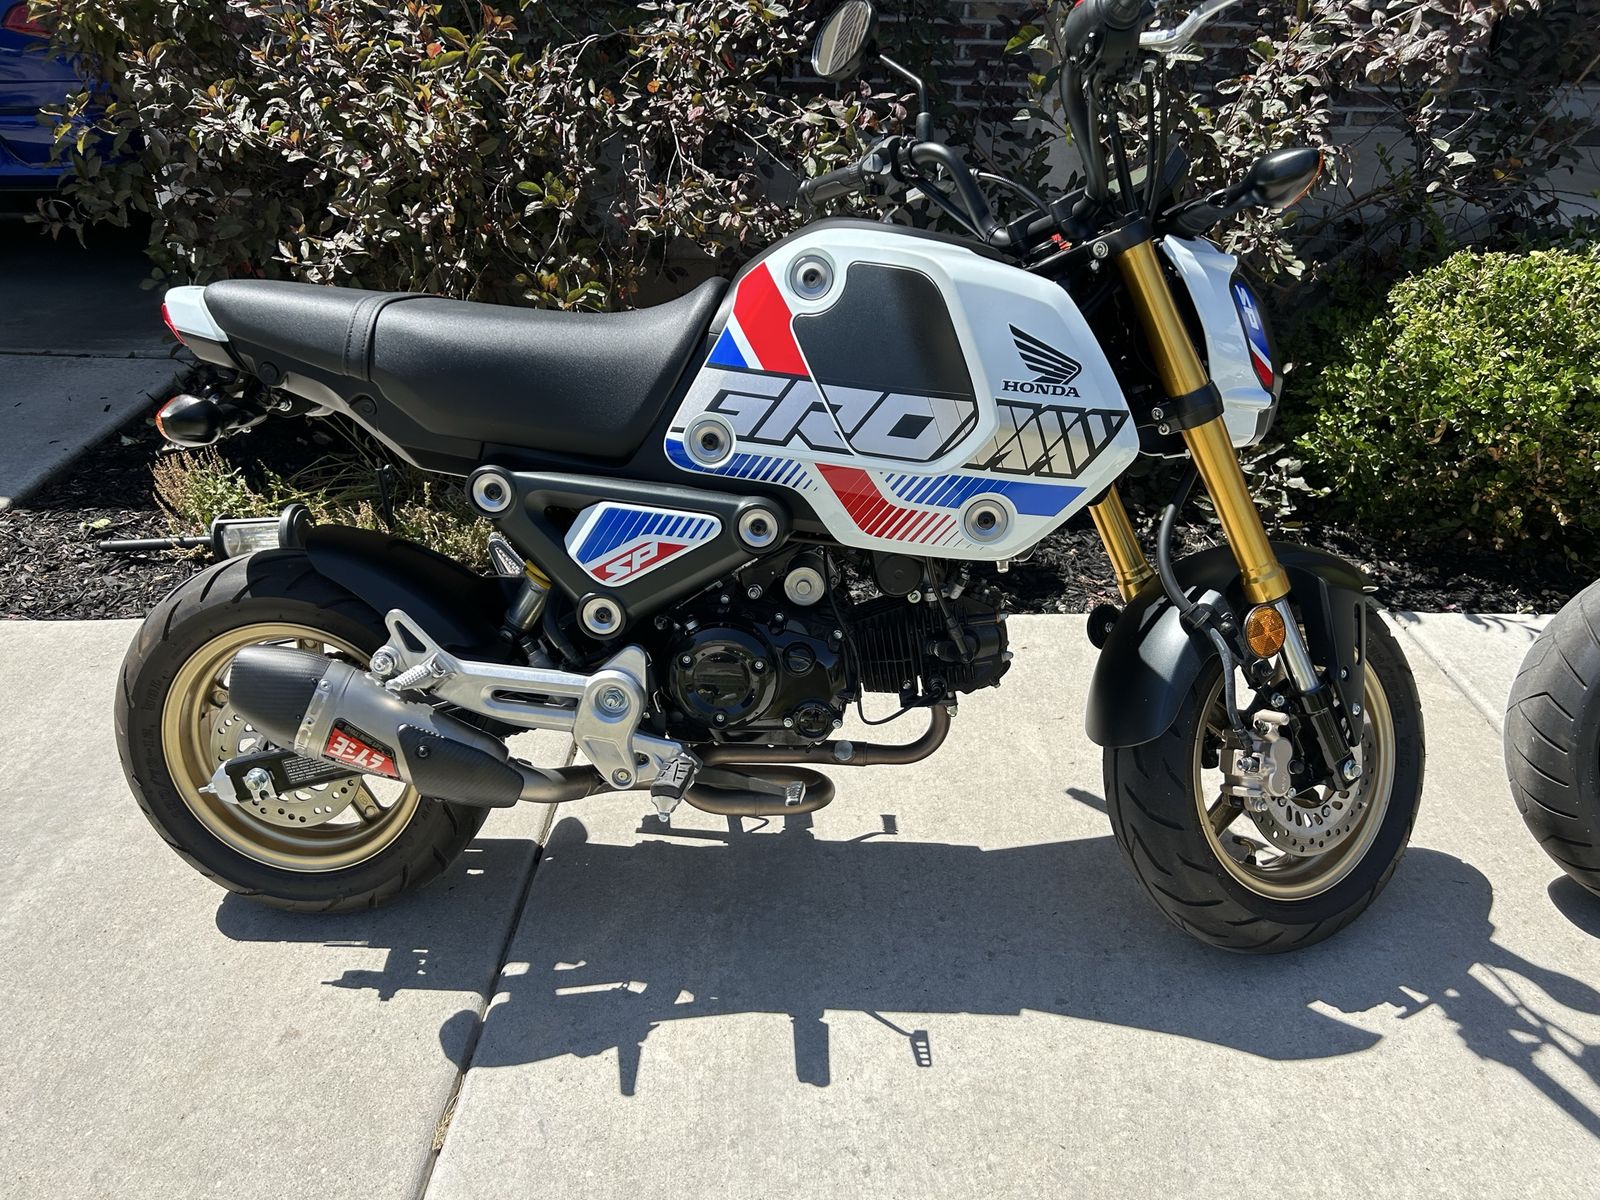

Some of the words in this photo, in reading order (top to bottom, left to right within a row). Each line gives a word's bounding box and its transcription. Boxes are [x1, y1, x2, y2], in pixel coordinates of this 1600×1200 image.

[1234, 284, 1260, 331] SP
[1002, 380, 1081, 398] HONDA
[604, 541, 660, 582] SP
[329, 736, 386, 769] ヨシムラ
